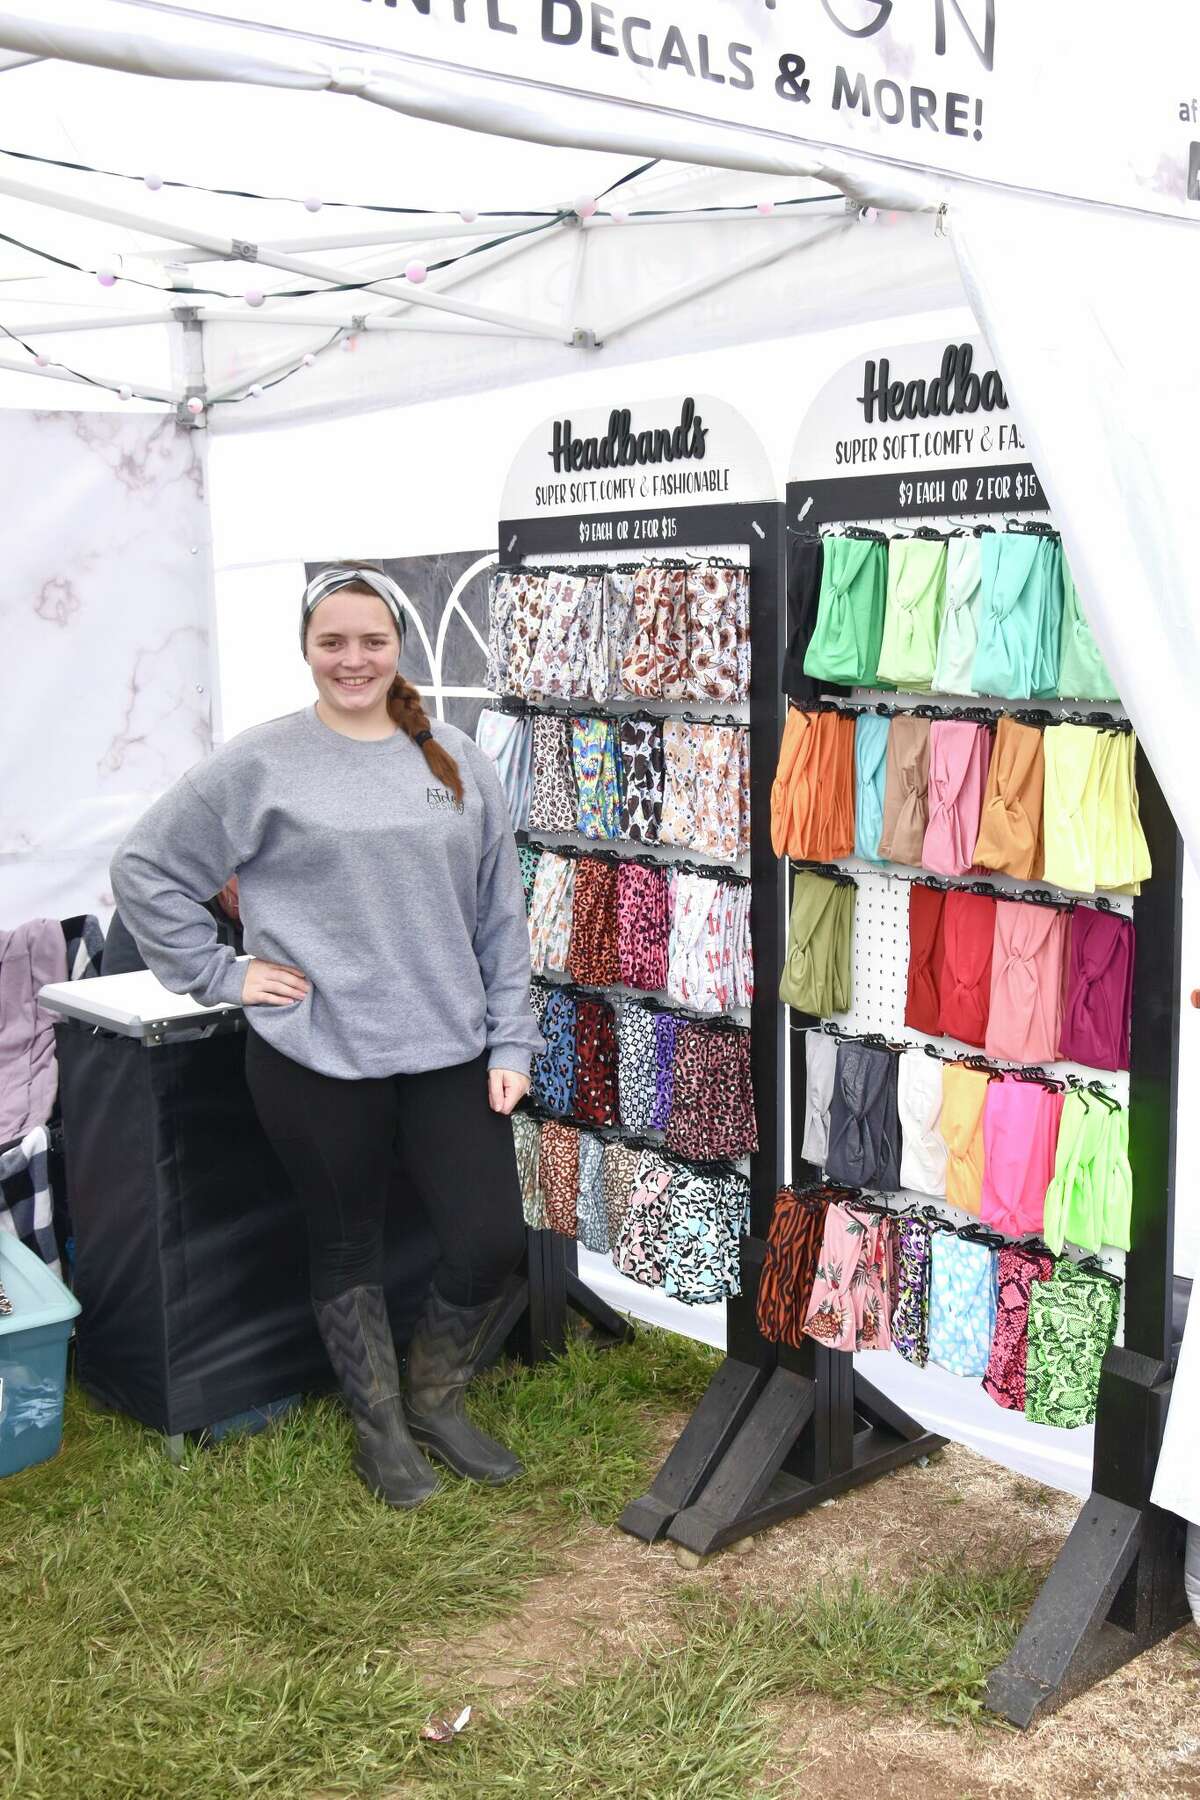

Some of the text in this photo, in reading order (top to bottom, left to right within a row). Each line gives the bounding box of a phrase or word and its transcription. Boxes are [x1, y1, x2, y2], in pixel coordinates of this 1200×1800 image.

[541, 0, 754, 90] DECALS
[775, 53, 811, 104] &
[831, 65, 983, 142] MORE!
[548, 397, 709, 473] Headbands
[835, 437, 877, 465] SUPER
[924, 428, 974, 457] COMFY
[980, 425, 993, 452] &
[535, 483, 566, 506] SUPER
[600, 478, 635, 501] COMFY
[640, 475, 649, 497] &
[653, 469, 730, 496] FASHIONABLE
[899, 471, 1037, 507] $9 EACH OR 2 FOR $15
[579, 515, 677, 543] $9 EACH OR 2 FOR $15
